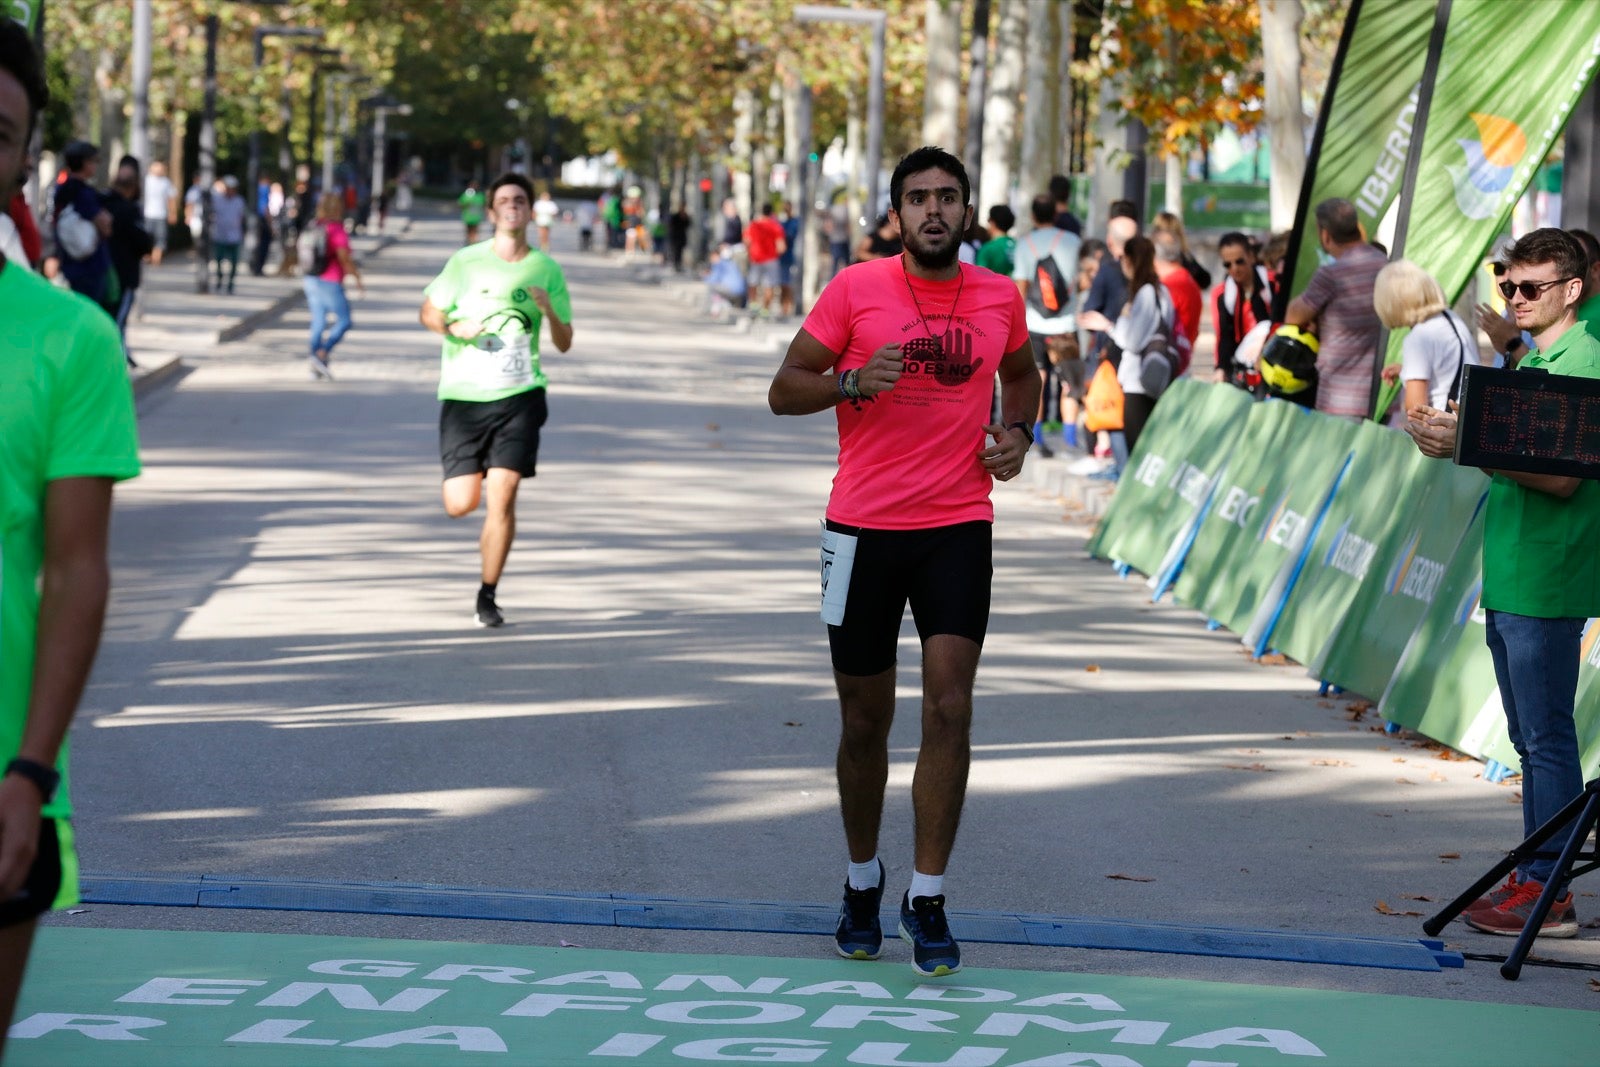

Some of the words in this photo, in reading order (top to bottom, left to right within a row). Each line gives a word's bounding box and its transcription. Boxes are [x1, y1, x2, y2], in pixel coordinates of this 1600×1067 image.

[1356, 83, 1421, 218] IBERD
[901, 317, 921, 333] MILLA
[924, 362, 944, 375] ES
[949, 363, 972, 377] NO
[307, 959, 1126, 1011] GRANADA
[113, 977, 449, 1012] EN
[500, 993, 1326, 1057] FORMA
[223, 1018, 508, 1053] LA
[588, 1032, 1240, 1067] IGUA
